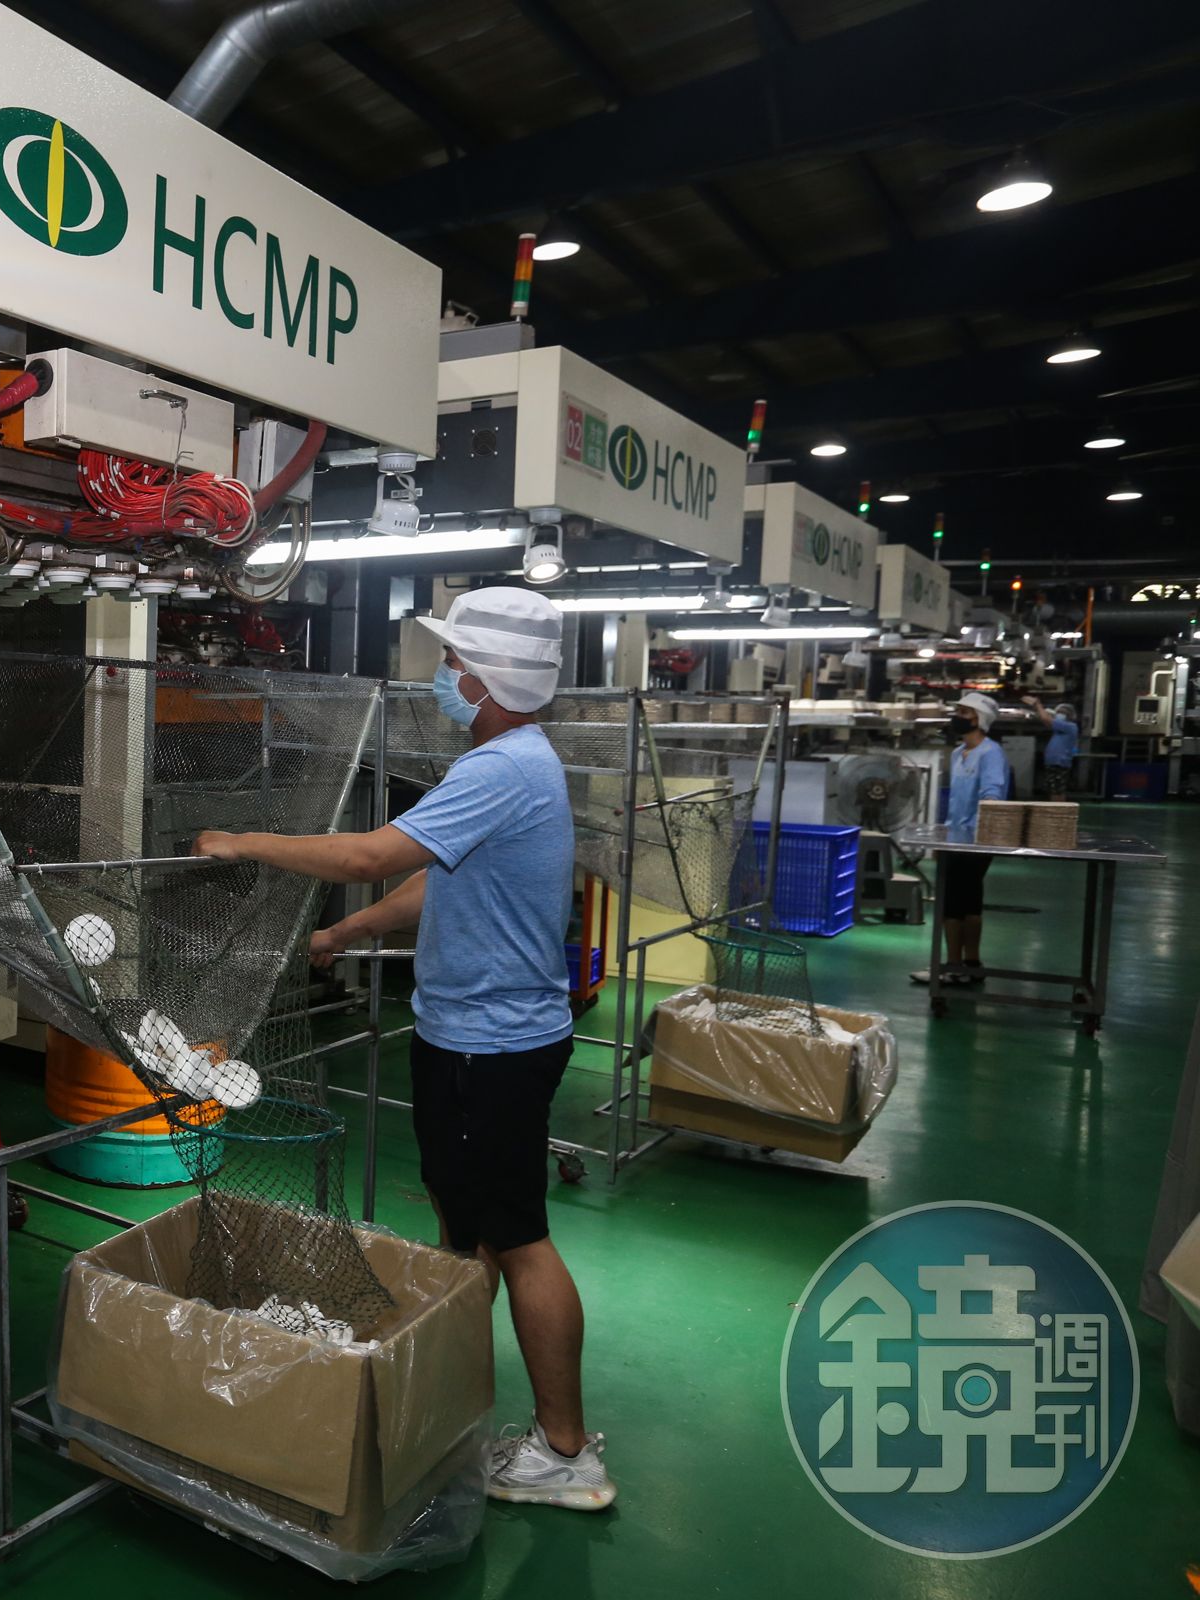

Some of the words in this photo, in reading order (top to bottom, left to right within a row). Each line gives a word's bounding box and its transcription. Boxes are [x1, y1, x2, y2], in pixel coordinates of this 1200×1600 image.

[153, 174, 358, 365] HCMP
[567, 420, 582, 449] 02
[652, 440, 717, 521] HCMP
